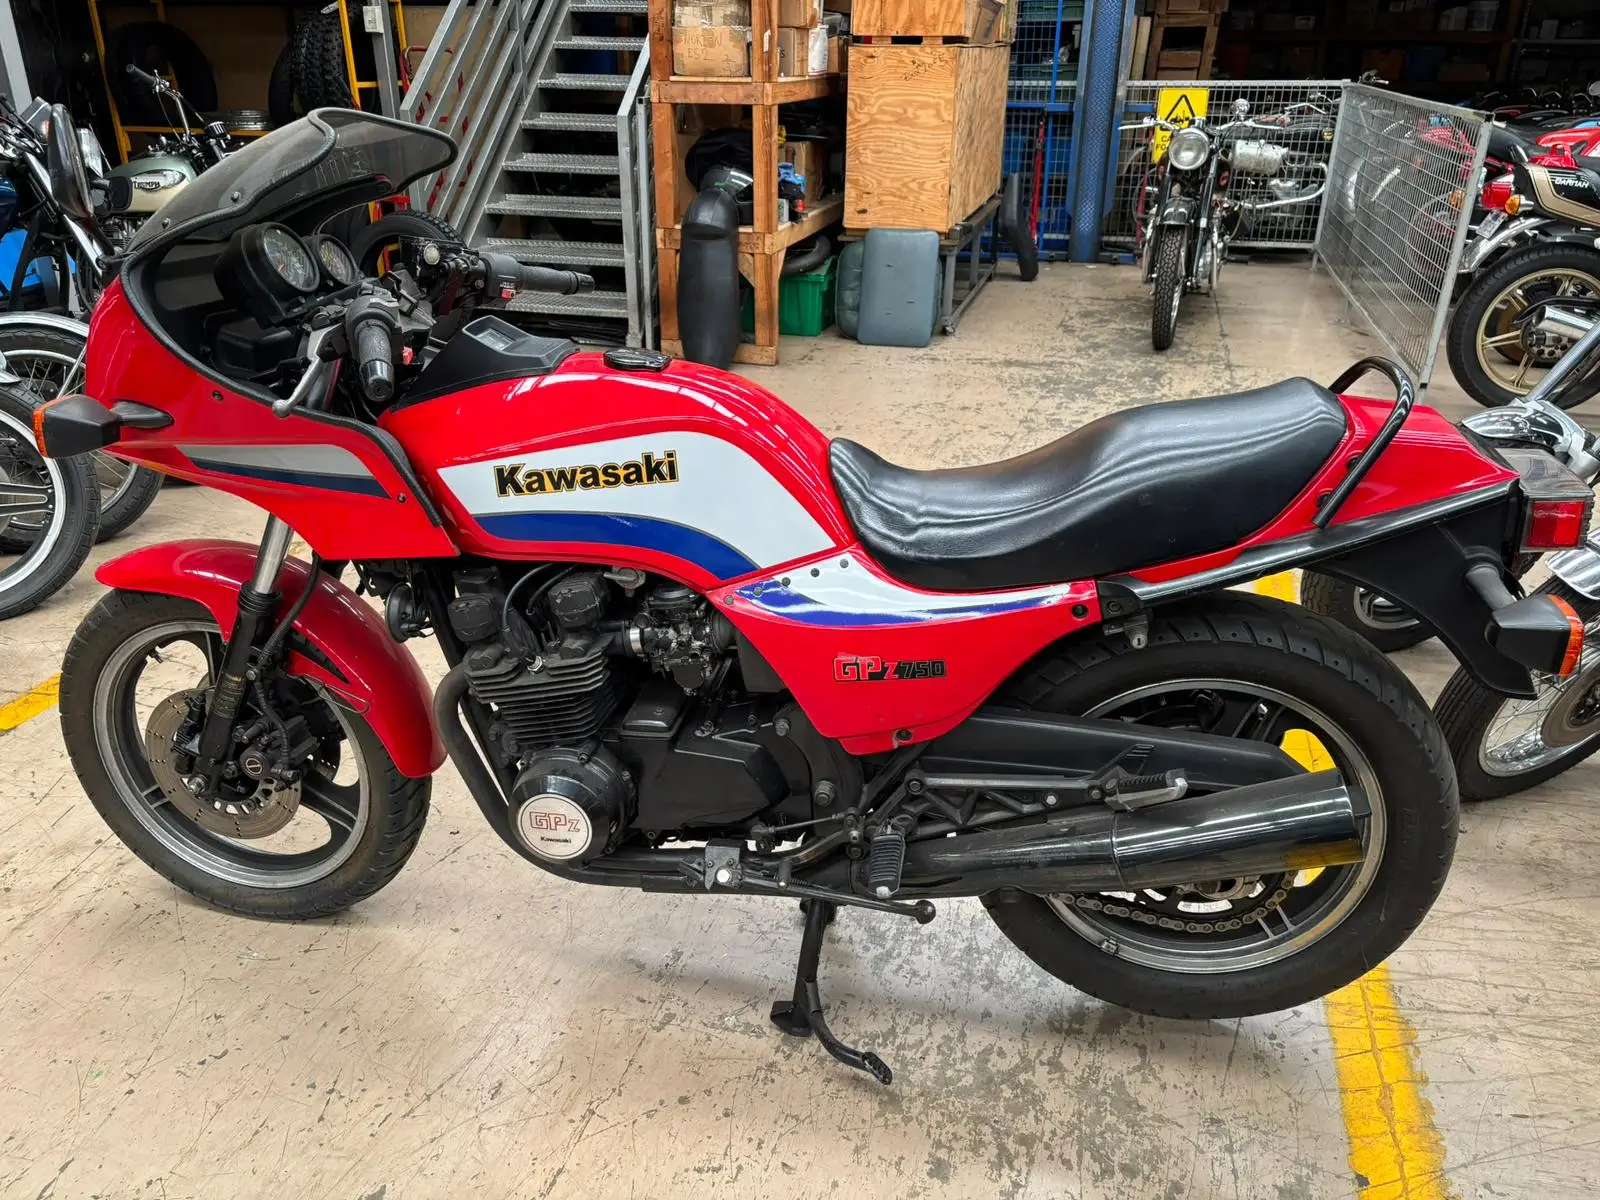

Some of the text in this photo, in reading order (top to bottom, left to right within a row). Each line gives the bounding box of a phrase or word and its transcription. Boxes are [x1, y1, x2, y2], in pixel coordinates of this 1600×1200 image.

[133, 180, 161, 190] TRIUMPH
[493, 450, 679, 497] Kawasaki
[540, 836, 572, 844] Kawasaki
